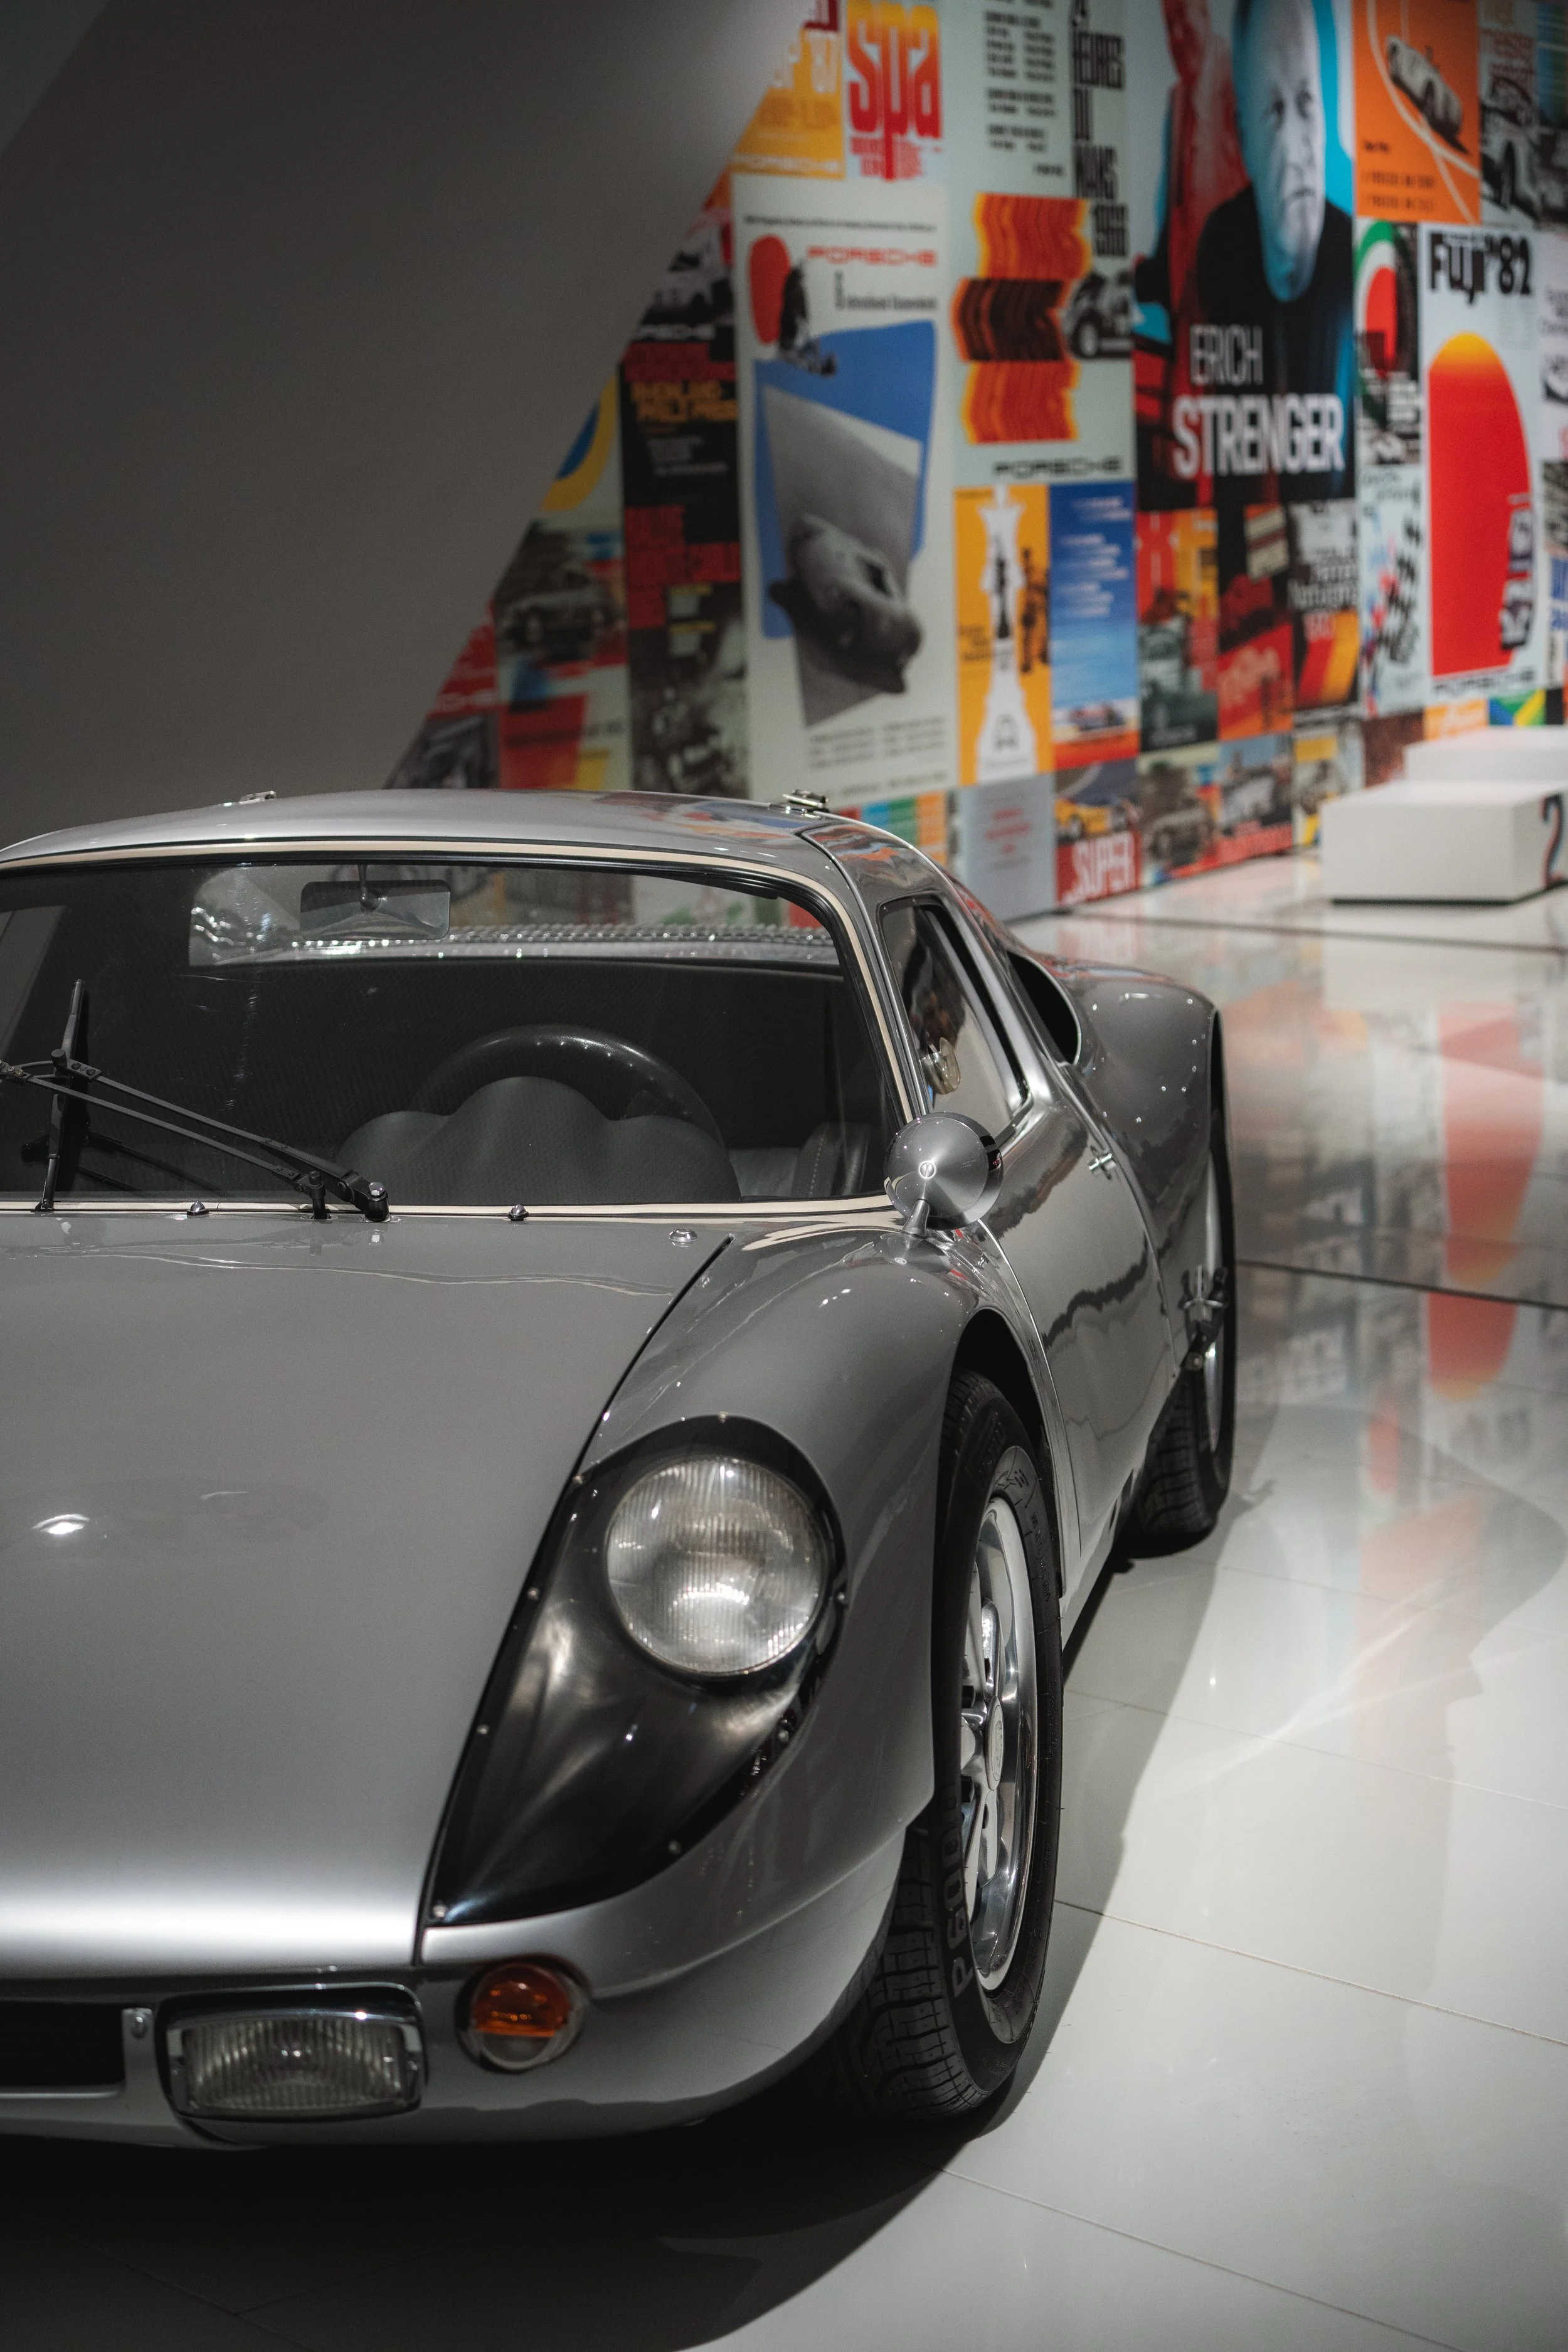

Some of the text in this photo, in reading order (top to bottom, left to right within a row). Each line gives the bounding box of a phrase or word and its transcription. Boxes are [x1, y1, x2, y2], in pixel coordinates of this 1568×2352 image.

[807, 245, 938, 267] PORSCHE
[1192, 326, 1263, 384] ERICH
[1172, 393, 1345, 479] STRENGER
[993, 456, 1121, 478] PORSCHE
[1539, 794, 1564, 887] 2
